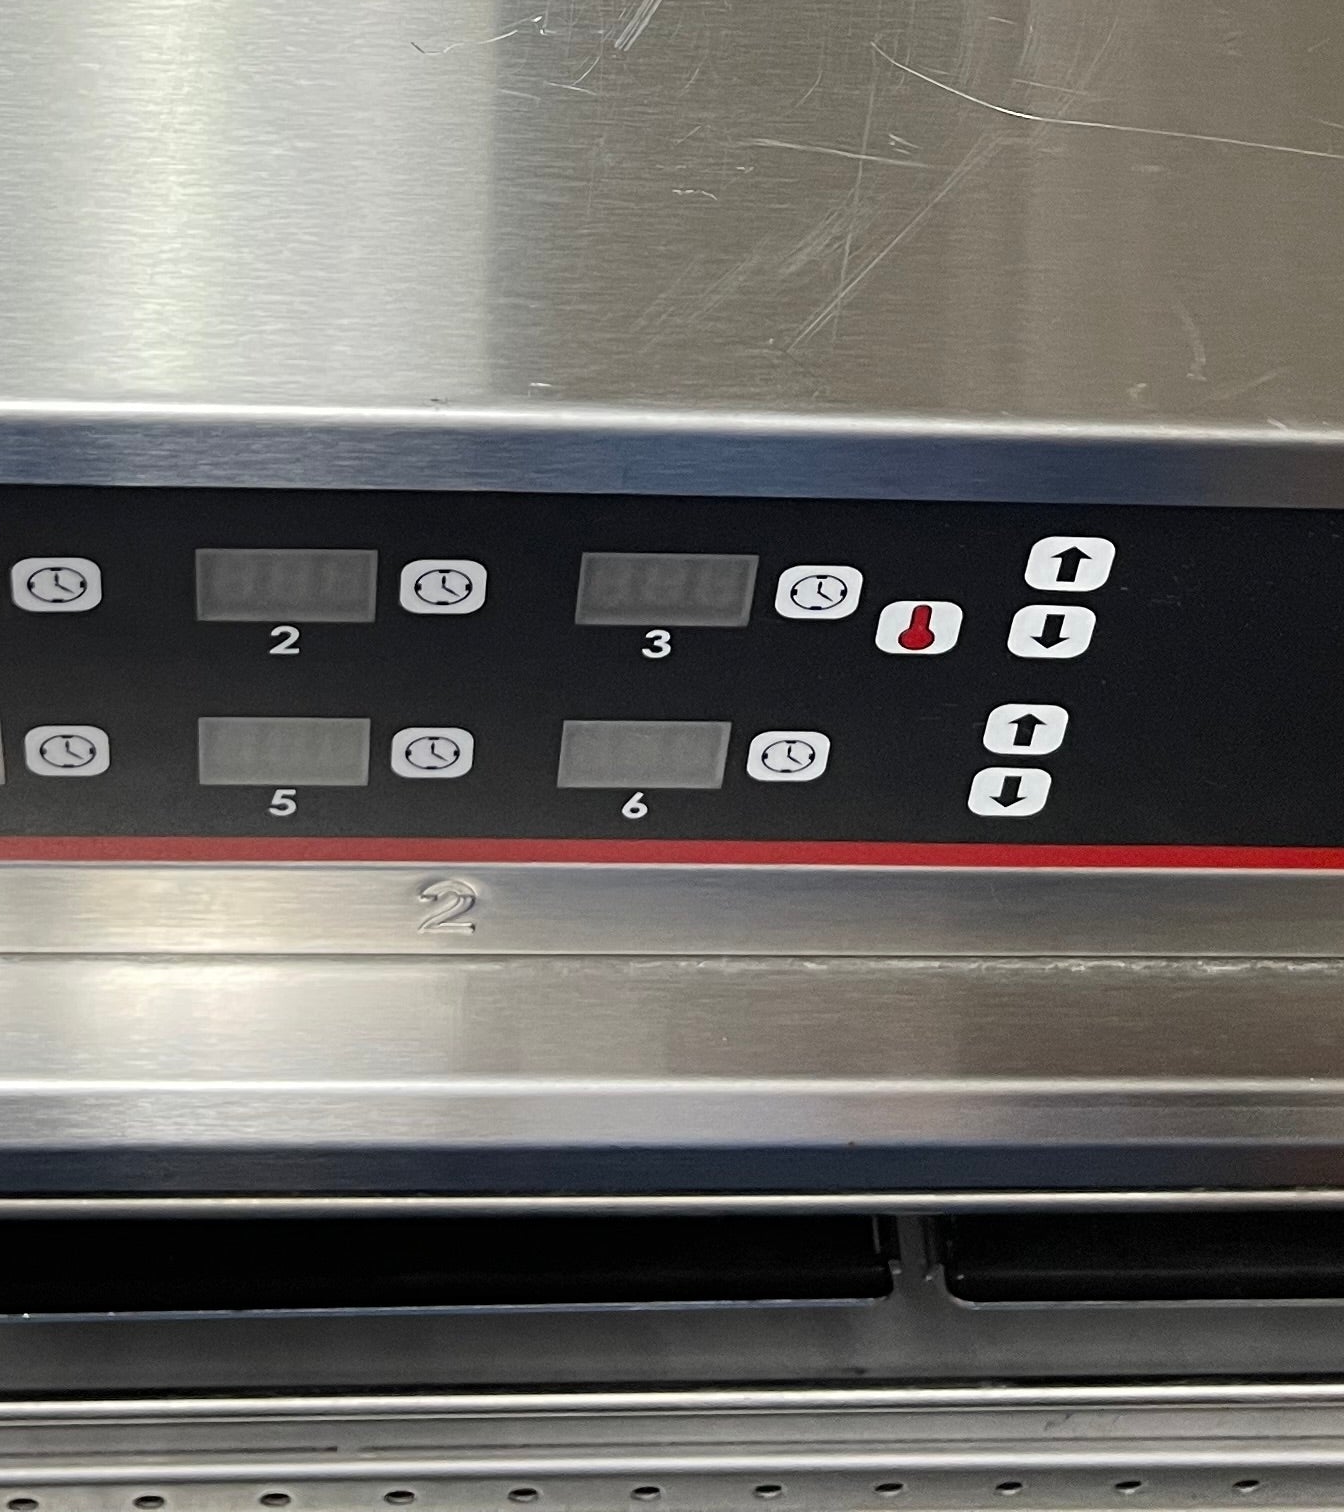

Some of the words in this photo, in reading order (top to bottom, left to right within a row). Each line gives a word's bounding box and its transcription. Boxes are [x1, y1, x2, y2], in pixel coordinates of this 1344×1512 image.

[269, 626, 300, 655] 2
[641, 630, 671, 658] 3
[269, 789, 297, 816] 5
[622, 792, 648, 819] 6
[418, 879, 478, 934] 2
